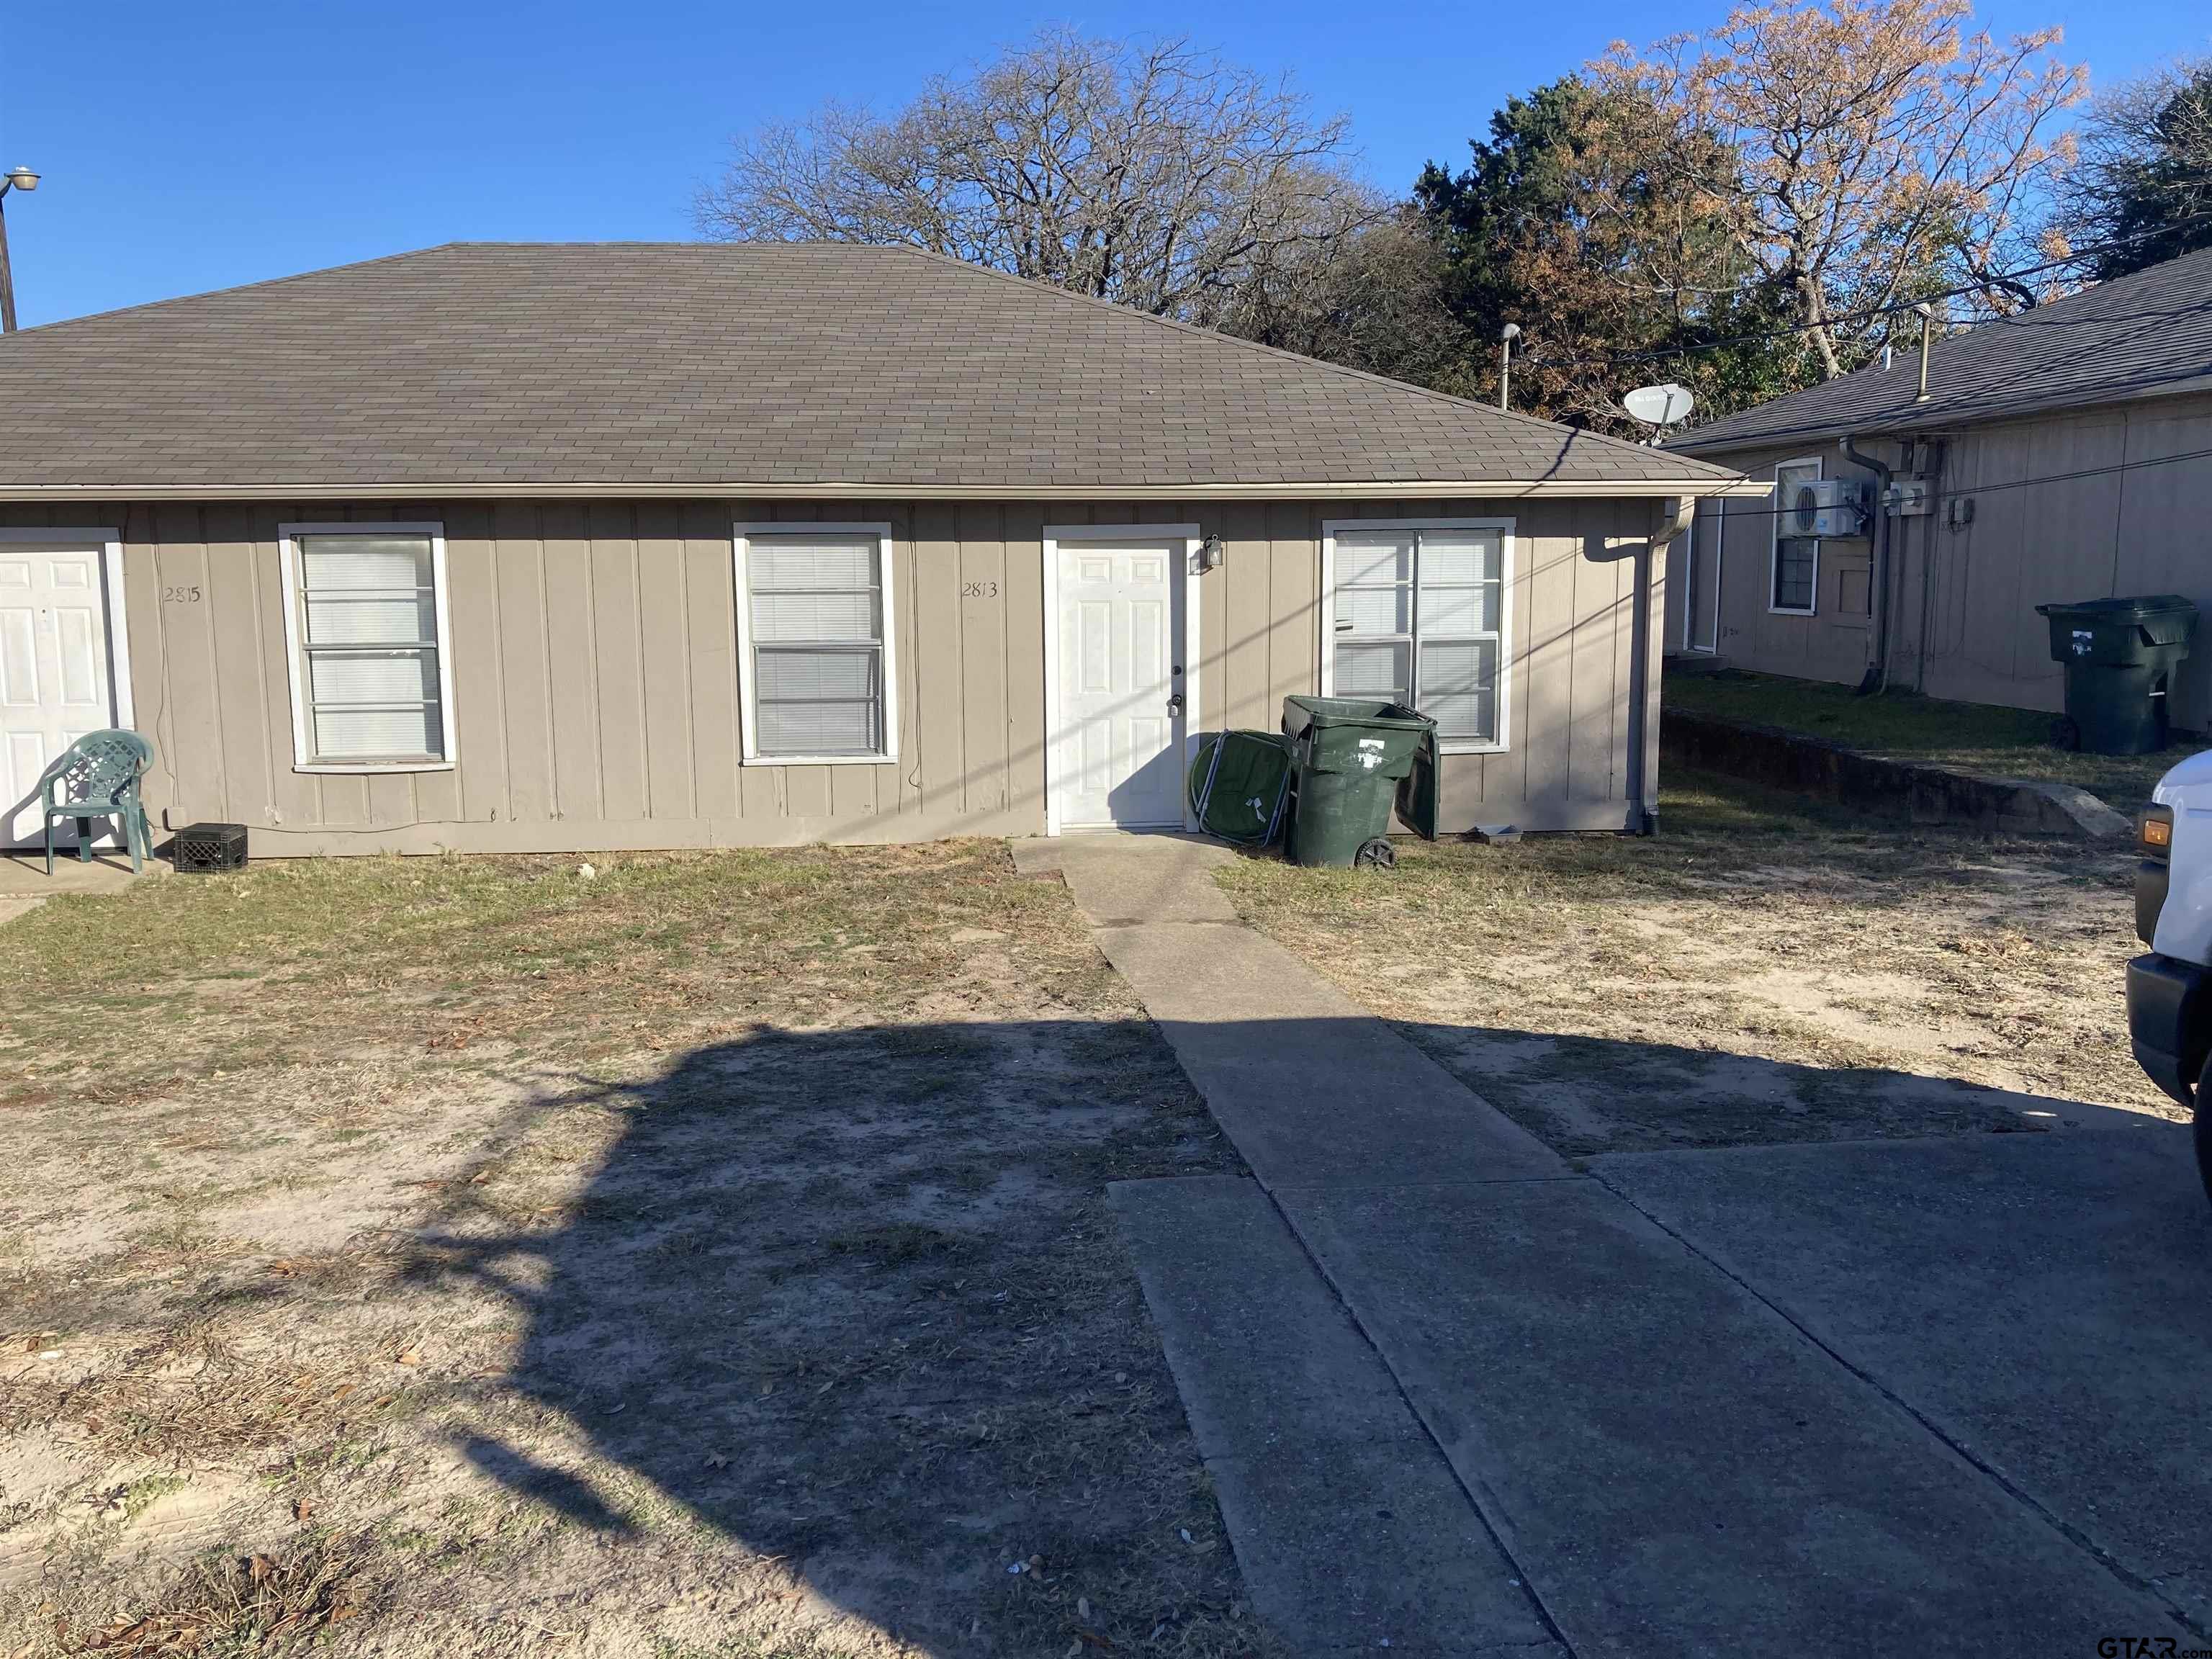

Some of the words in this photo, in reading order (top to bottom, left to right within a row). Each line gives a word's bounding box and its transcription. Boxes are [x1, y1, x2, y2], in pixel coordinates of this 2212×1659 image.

[164, 586, 201, 603] 2815
[961, 582, 997, 598] 2813
[1358, 750, 1382, 763] TYER
